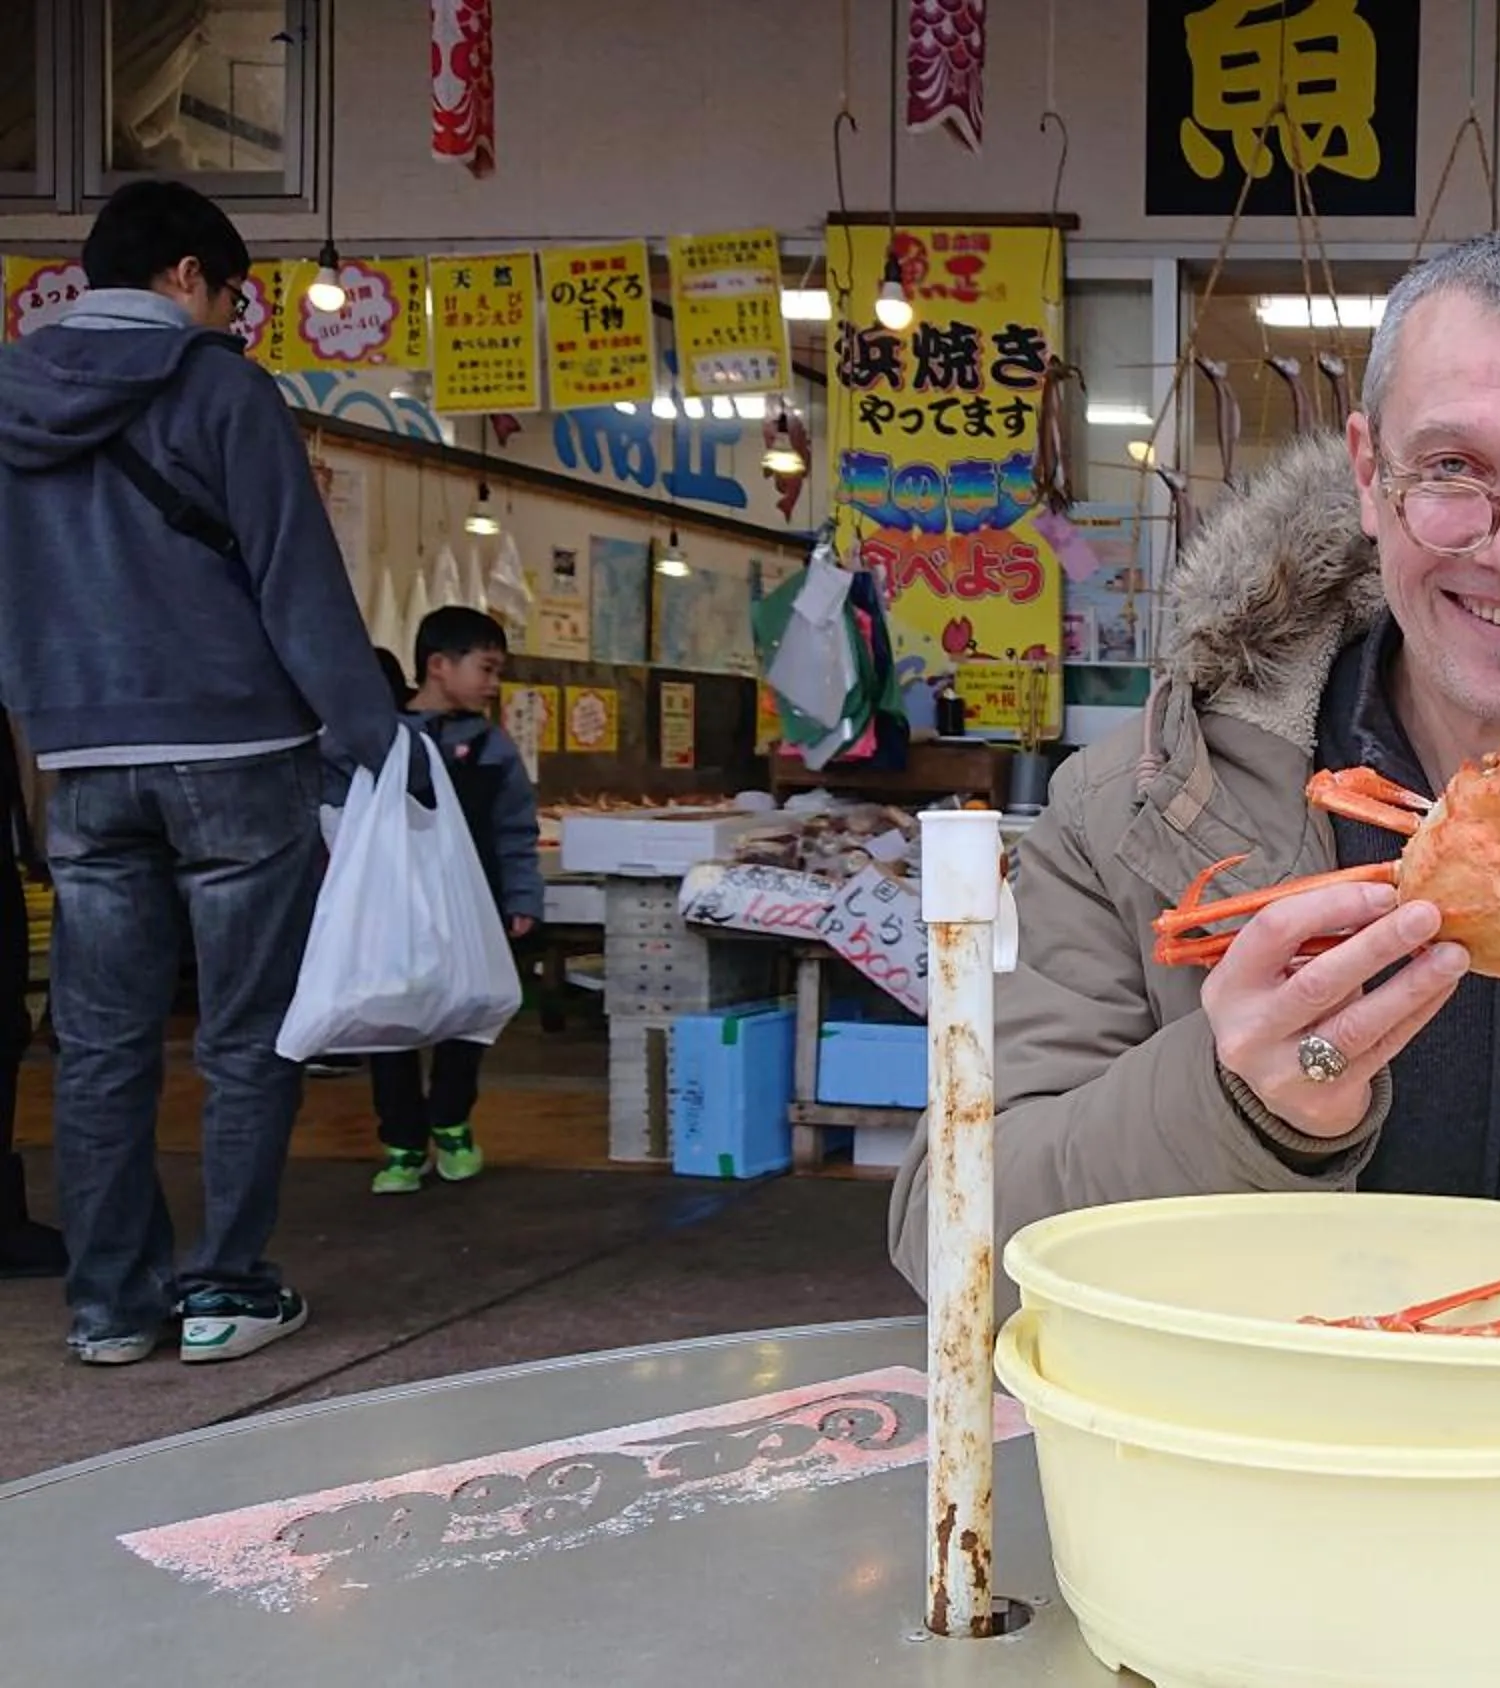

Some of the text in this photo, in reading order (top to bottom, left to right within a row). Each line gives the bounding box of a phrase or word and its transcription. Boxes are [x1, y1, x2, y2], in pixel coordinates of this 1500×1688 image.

[1181, 0, 1380, 180] 魚
[551, 273, 644, 306] のどぐろ
[834, 319, 1047, 390] 浜焼き
[859, 395, 1032, 437] やってます
